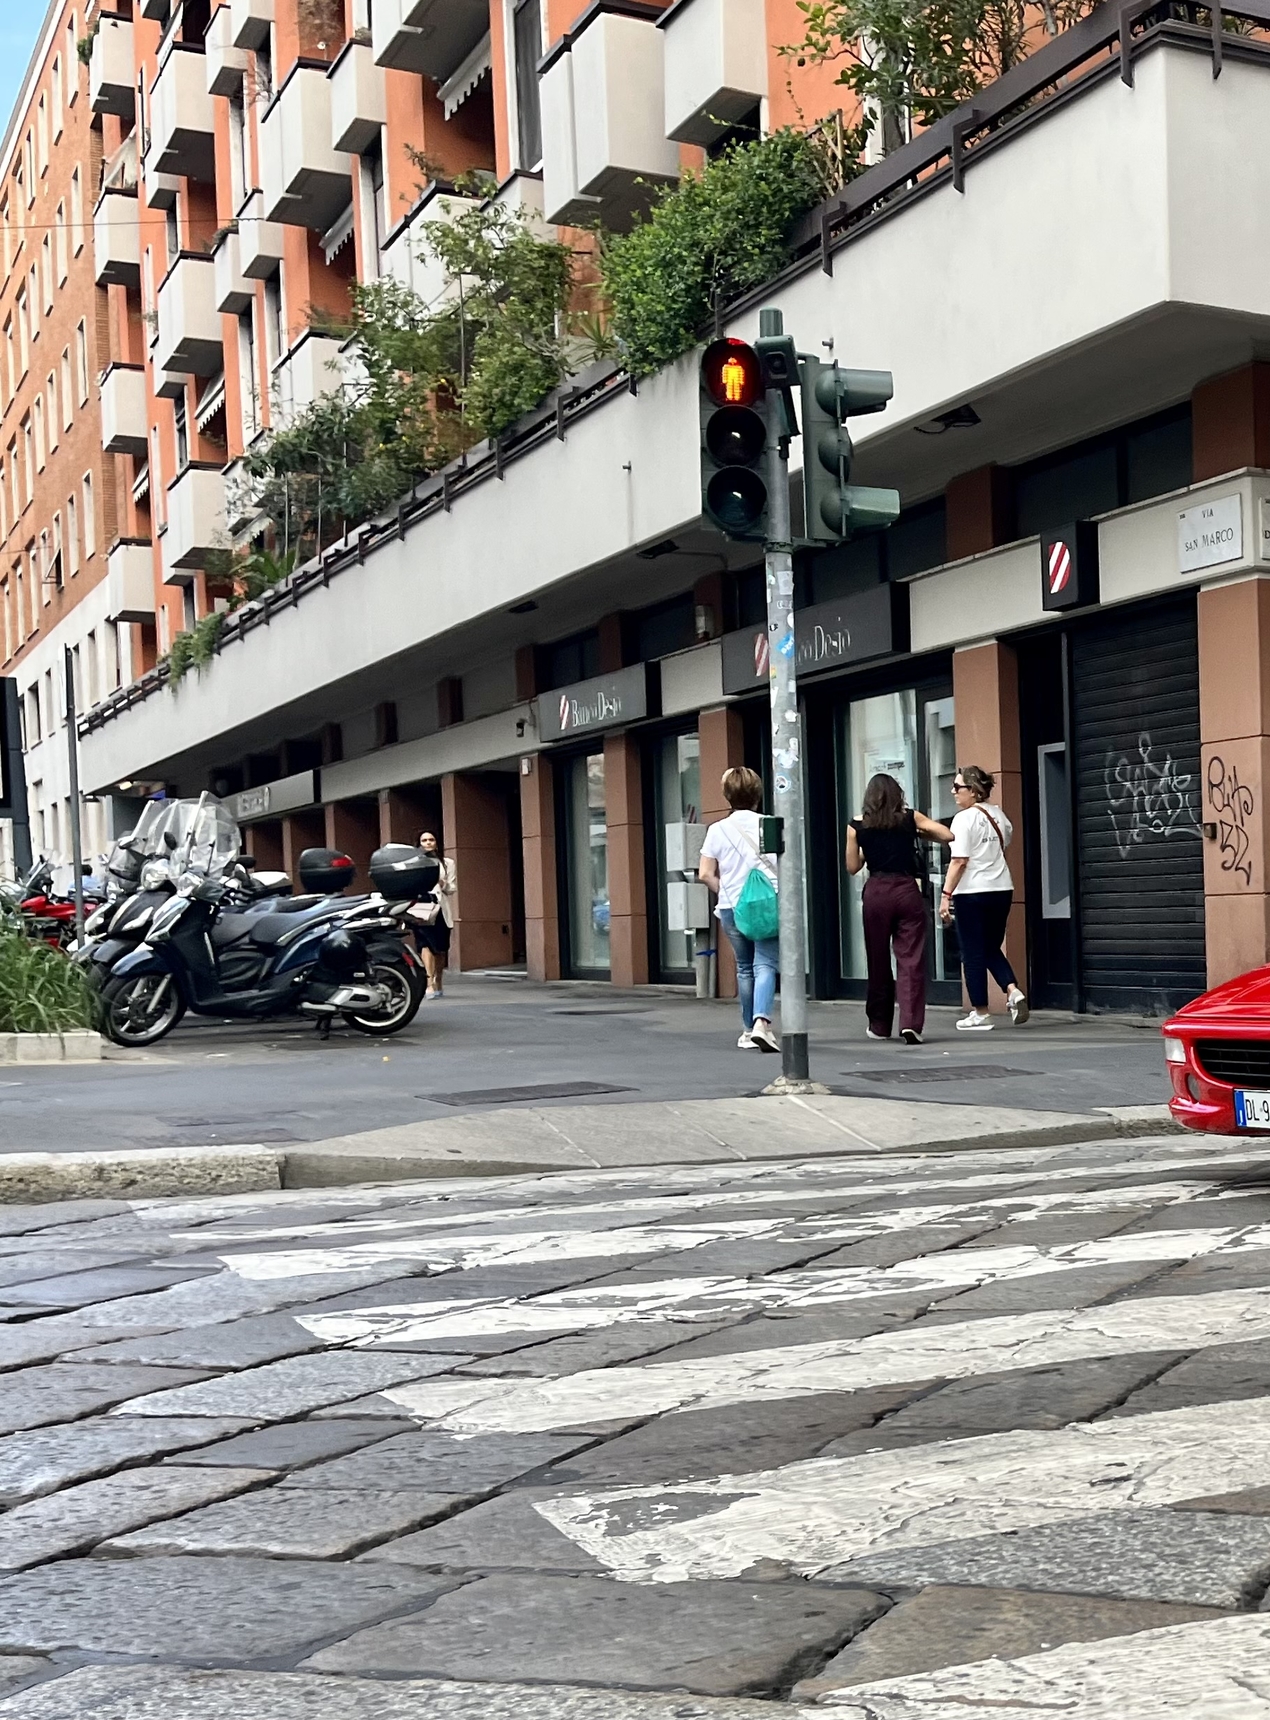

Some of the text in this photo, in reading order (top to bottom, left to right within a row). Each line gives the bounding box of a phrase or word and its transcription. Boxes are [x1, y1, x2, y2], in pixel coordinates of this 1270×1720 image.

[1201, 508, 1215, 519] VIA
[1185, 527, 1234, 552] SAN MARCO
